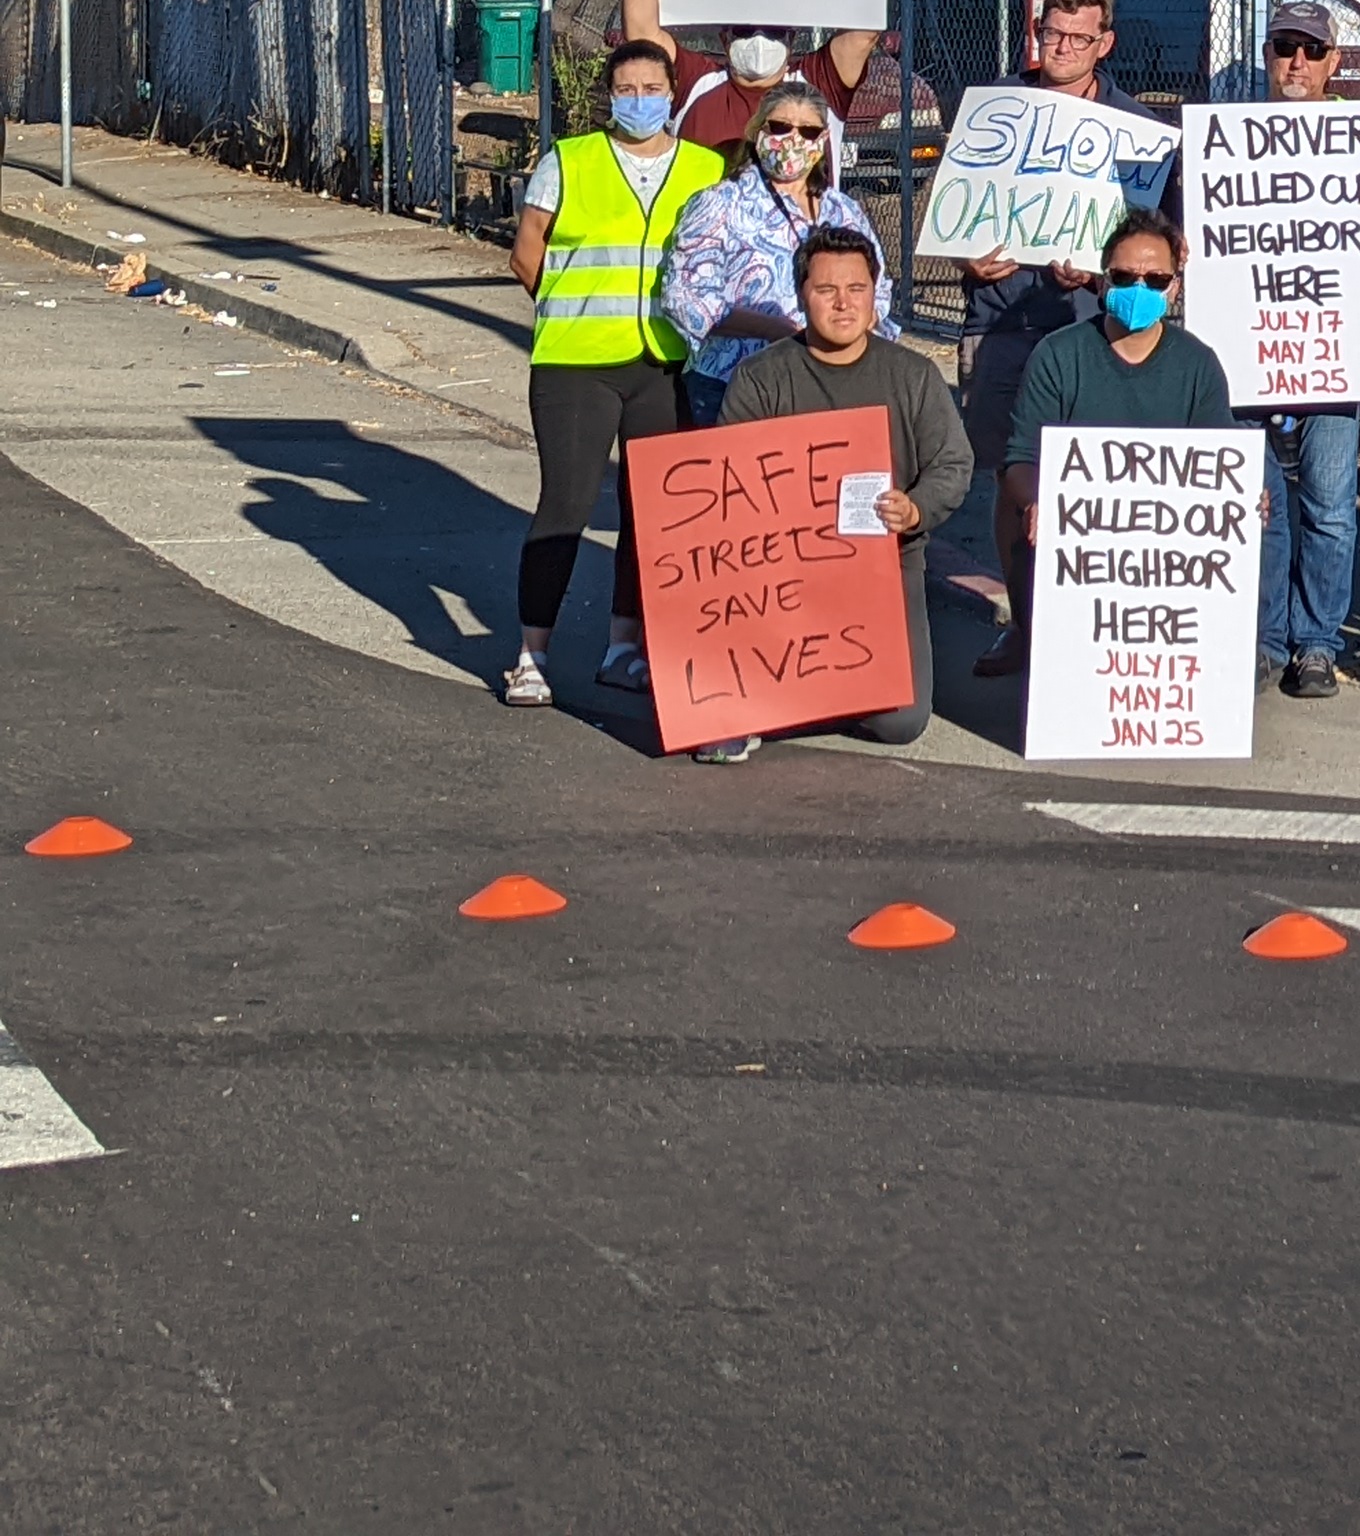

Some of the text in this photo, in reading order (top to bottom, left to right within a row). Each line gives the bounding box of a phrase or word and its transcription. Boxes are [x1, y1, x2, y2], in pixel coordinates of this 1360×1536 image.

[947, 95, 1174, 191] SLOW
[1203, 113, 1235, 160] A
[930, 177, 1128, 252] OAKLAN
[1202, 170, 1315, 212] KILLED
[1251, 262, 1342, 304] HERE
[1250, 309, 1344, 334] JULY 17
[1257, 337, 1341, 365] MAY 21
[1257, 370, 1349, 396] JAN 25
[660, 440, 850, 532] SAFE
[1059, 436, 1246, 494] A DRIVER
[1057, 492, 1247, 545] KILLED OUR
[653, 523, 857, 590] STREETS
[1055, 545, 1237, 595] NEIGHBOR
[696, 578, 805, 634] SAVE
[1093, 597, 1199, 645] HERE
[685, 624, 874, 706] LIVES
[1096, 649, 1201, 682] JULY 17
[1109, 683, 1194, 713] MAY 21
[1101, 717, 1204, 748] JAN 25
